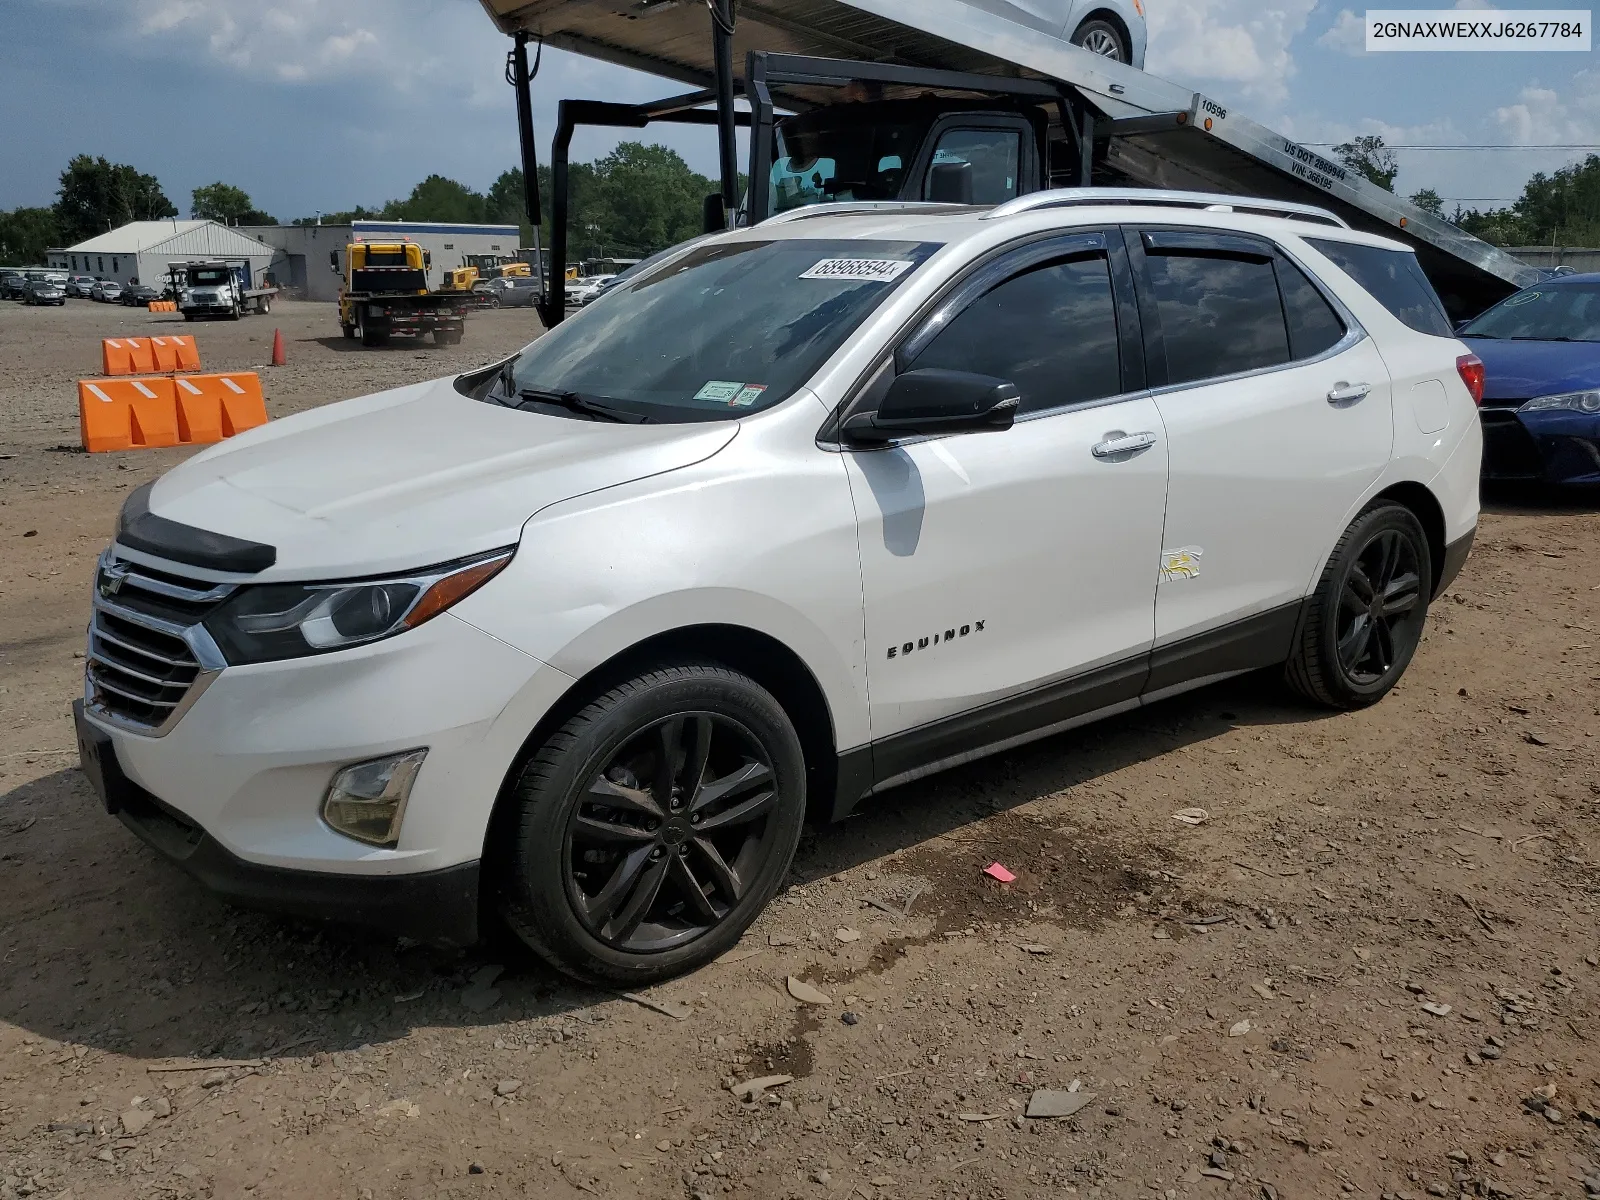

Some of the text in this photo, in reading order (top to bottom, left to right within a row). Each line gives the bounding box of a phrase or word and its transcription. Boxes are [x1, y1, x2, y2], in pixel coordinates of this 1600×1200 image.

[1202, 99, 1227, 119] 10596
[1284, 142, 1296, 156] US
[1297, 149, 1314, 164] DOT
[887, 619, 985, 660] EQUINOX
